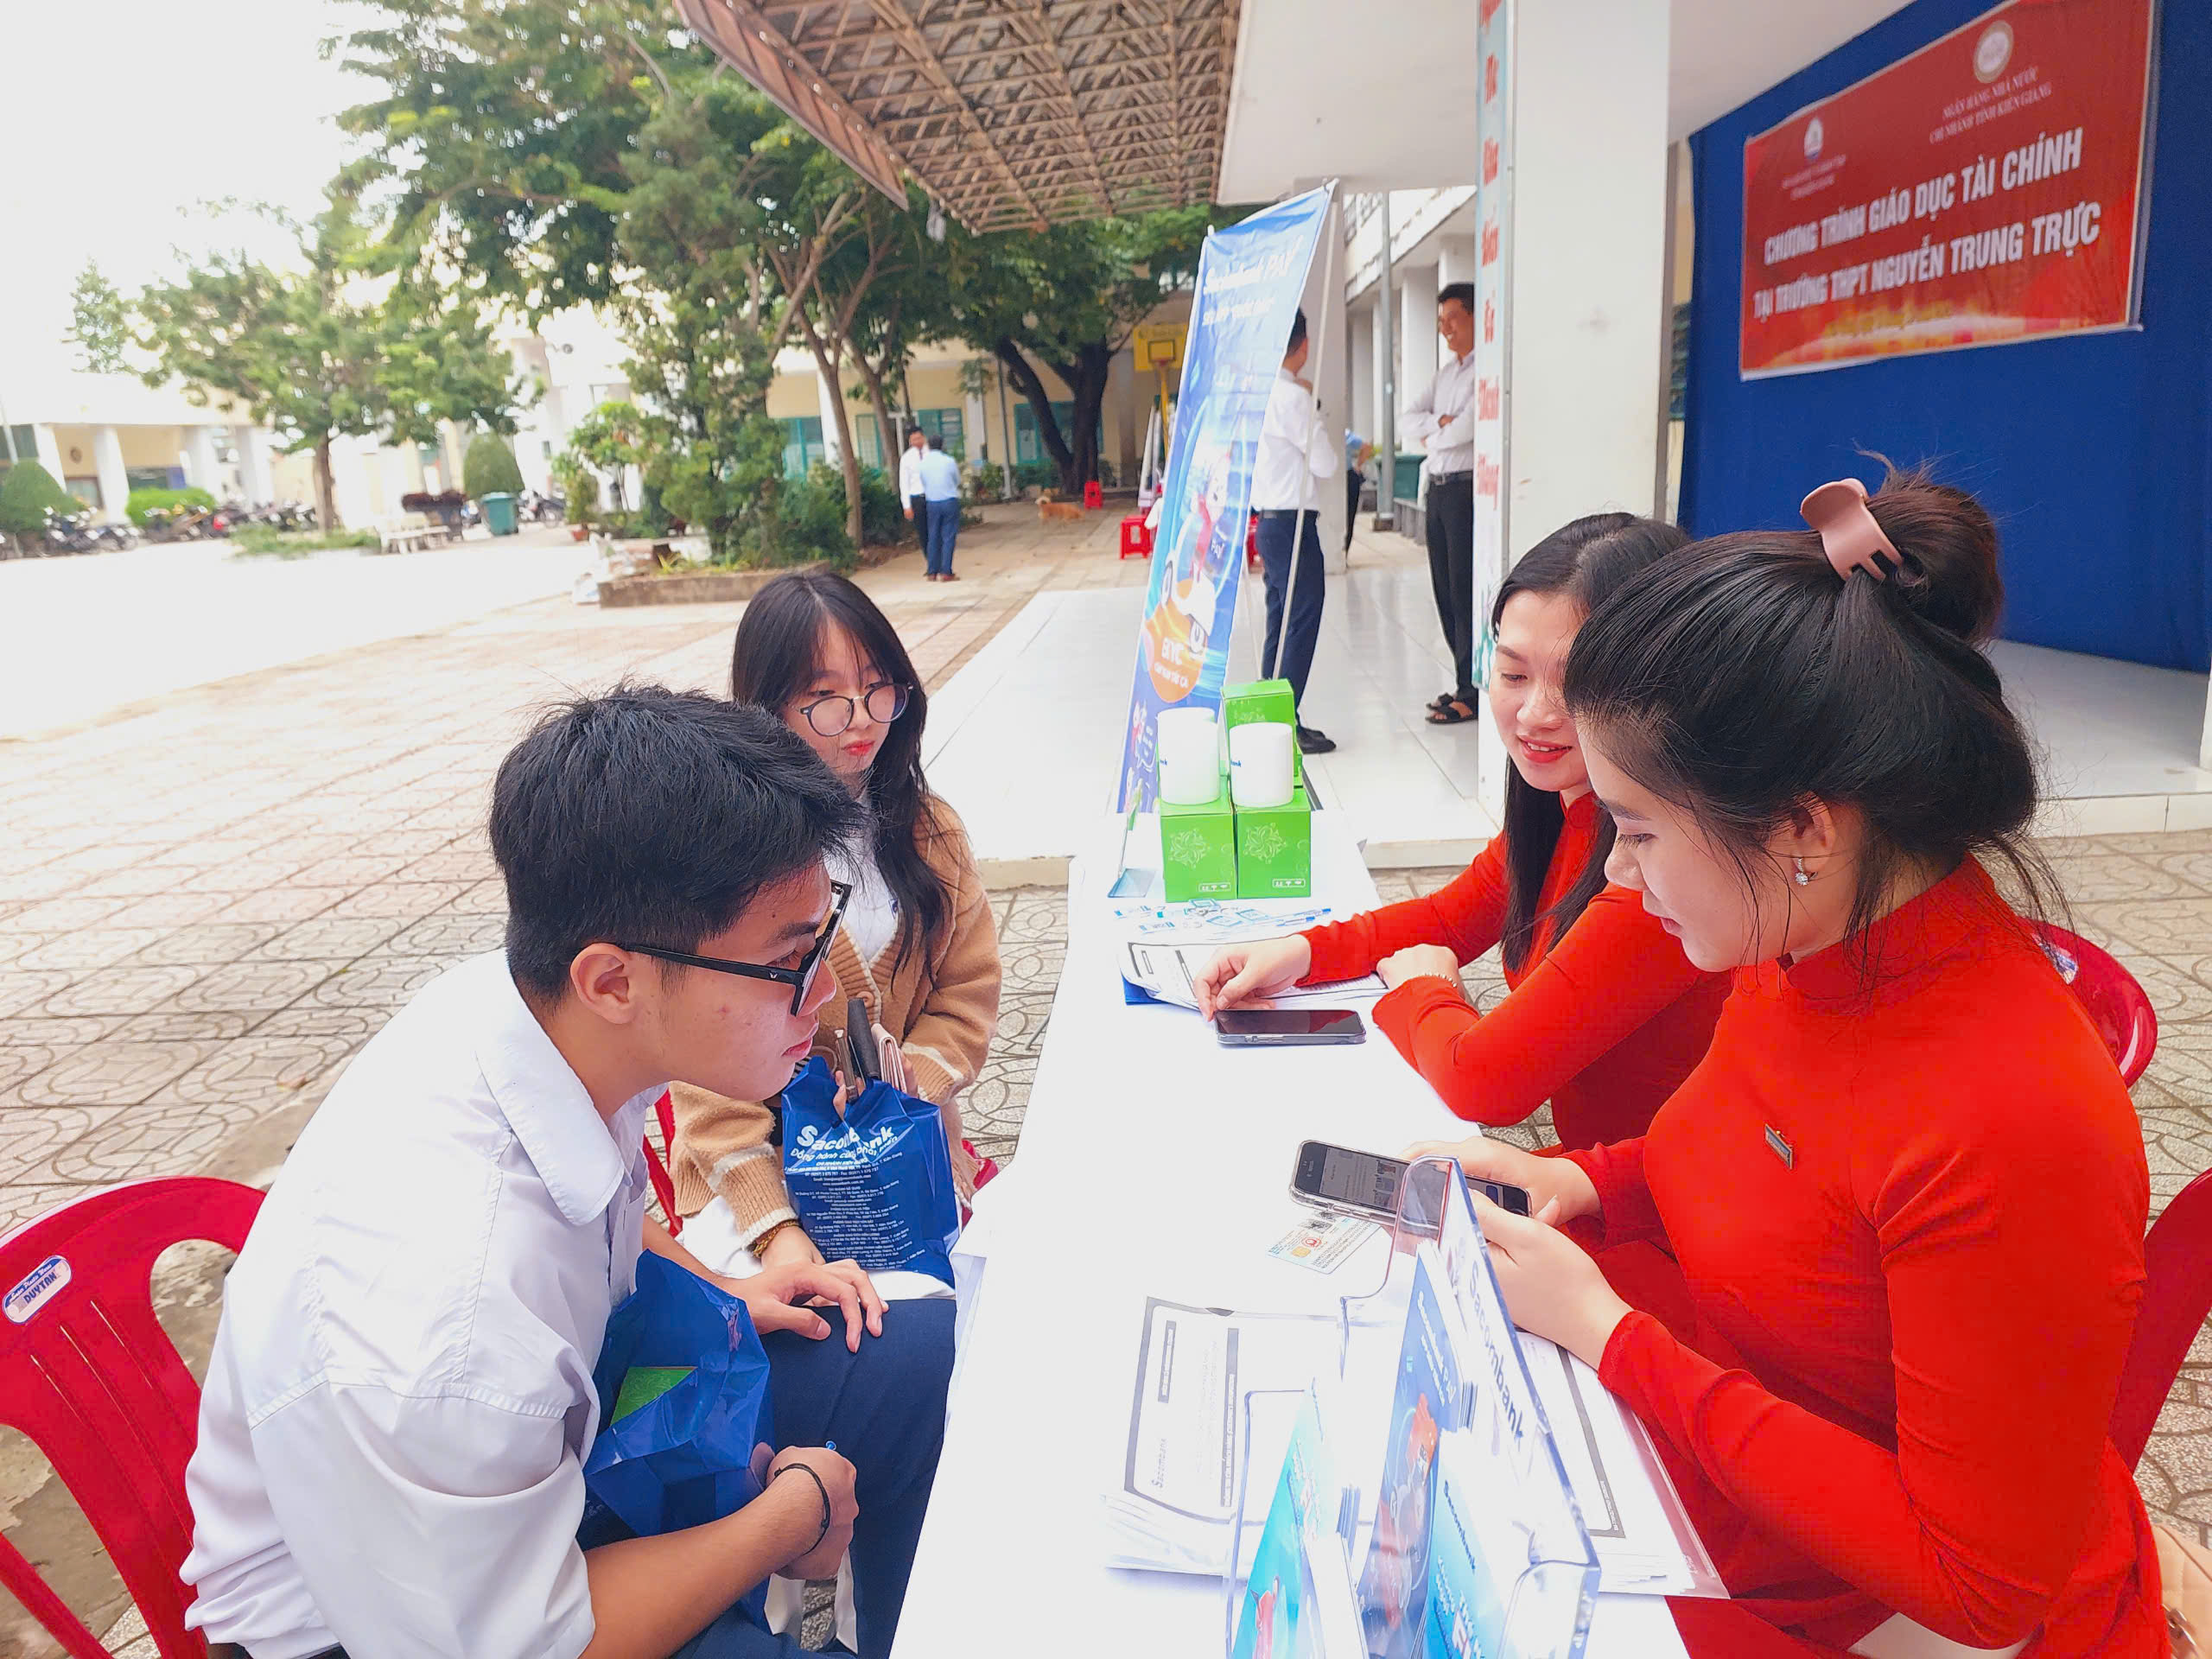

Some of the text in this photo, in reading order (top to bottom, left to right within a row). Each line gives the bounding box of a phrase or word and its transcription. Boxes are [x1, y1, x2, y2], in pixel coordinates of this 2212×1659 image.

[1764, 221, 1818, 265] CHƯƠNG
[1821, 206, 1867, 248] TRÌNH
[1868, 186, 1911, 233] GIÁO
[1915, 173, 1955, 221] DỤC
[1961, 154, 1995, 204] TÀI
[2002, 126, 2083, 191] CHÍNH
[1753, 200, 2101, 323] TẠI TRƯỜNG THPT NGUYỄN TRUNG TRỰC
[25, 1272, 57, 1304] DUYTAN
[1471, 1261, 1523, 1441] Sacombank
